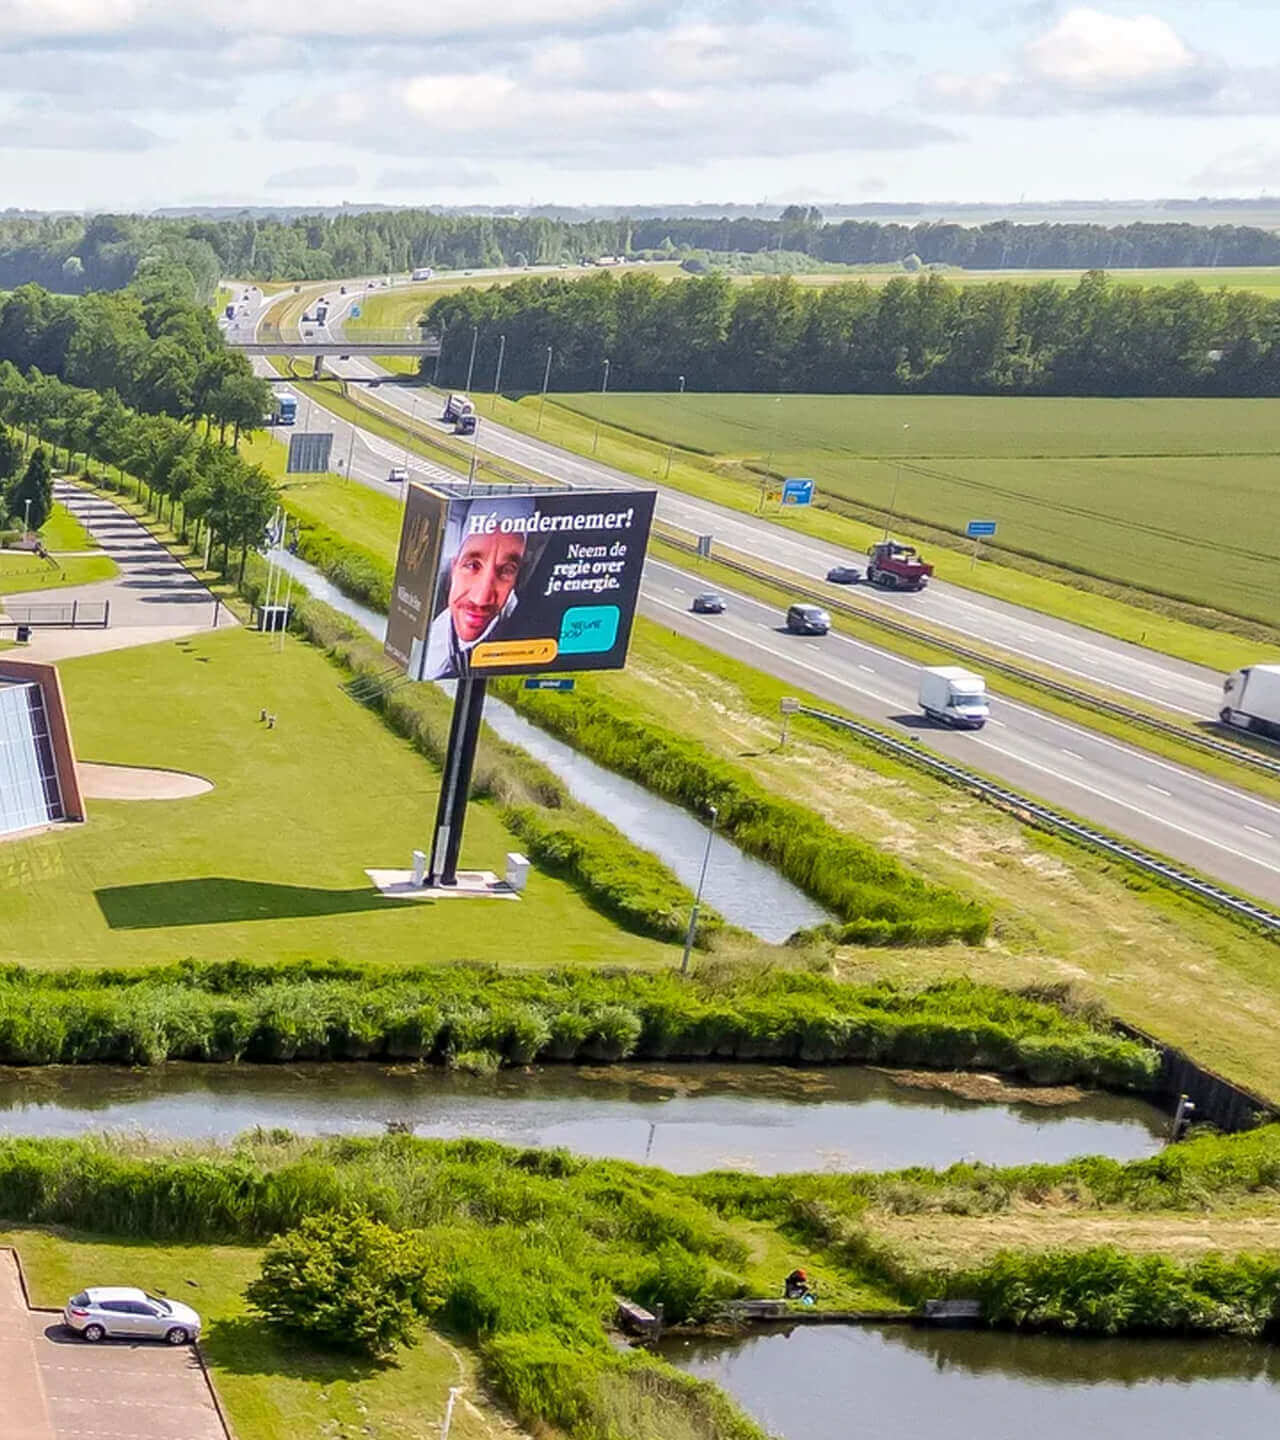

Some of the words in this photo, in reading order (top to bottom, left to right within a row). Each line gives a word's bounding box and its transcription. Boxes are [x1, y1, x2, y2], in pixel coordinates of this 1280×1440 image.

[469, 511, 497, 534] Hé
[500, 508, 634, 533] ondernemer!
[567, 543, 607, 559] Neem
[609, 541, 627, 556] de
[553, 560, 590, 578] regie
[592, 560, 625, 574] over
[544, 577, 561, 596] je
[563, 574, 620, 593] energie.
